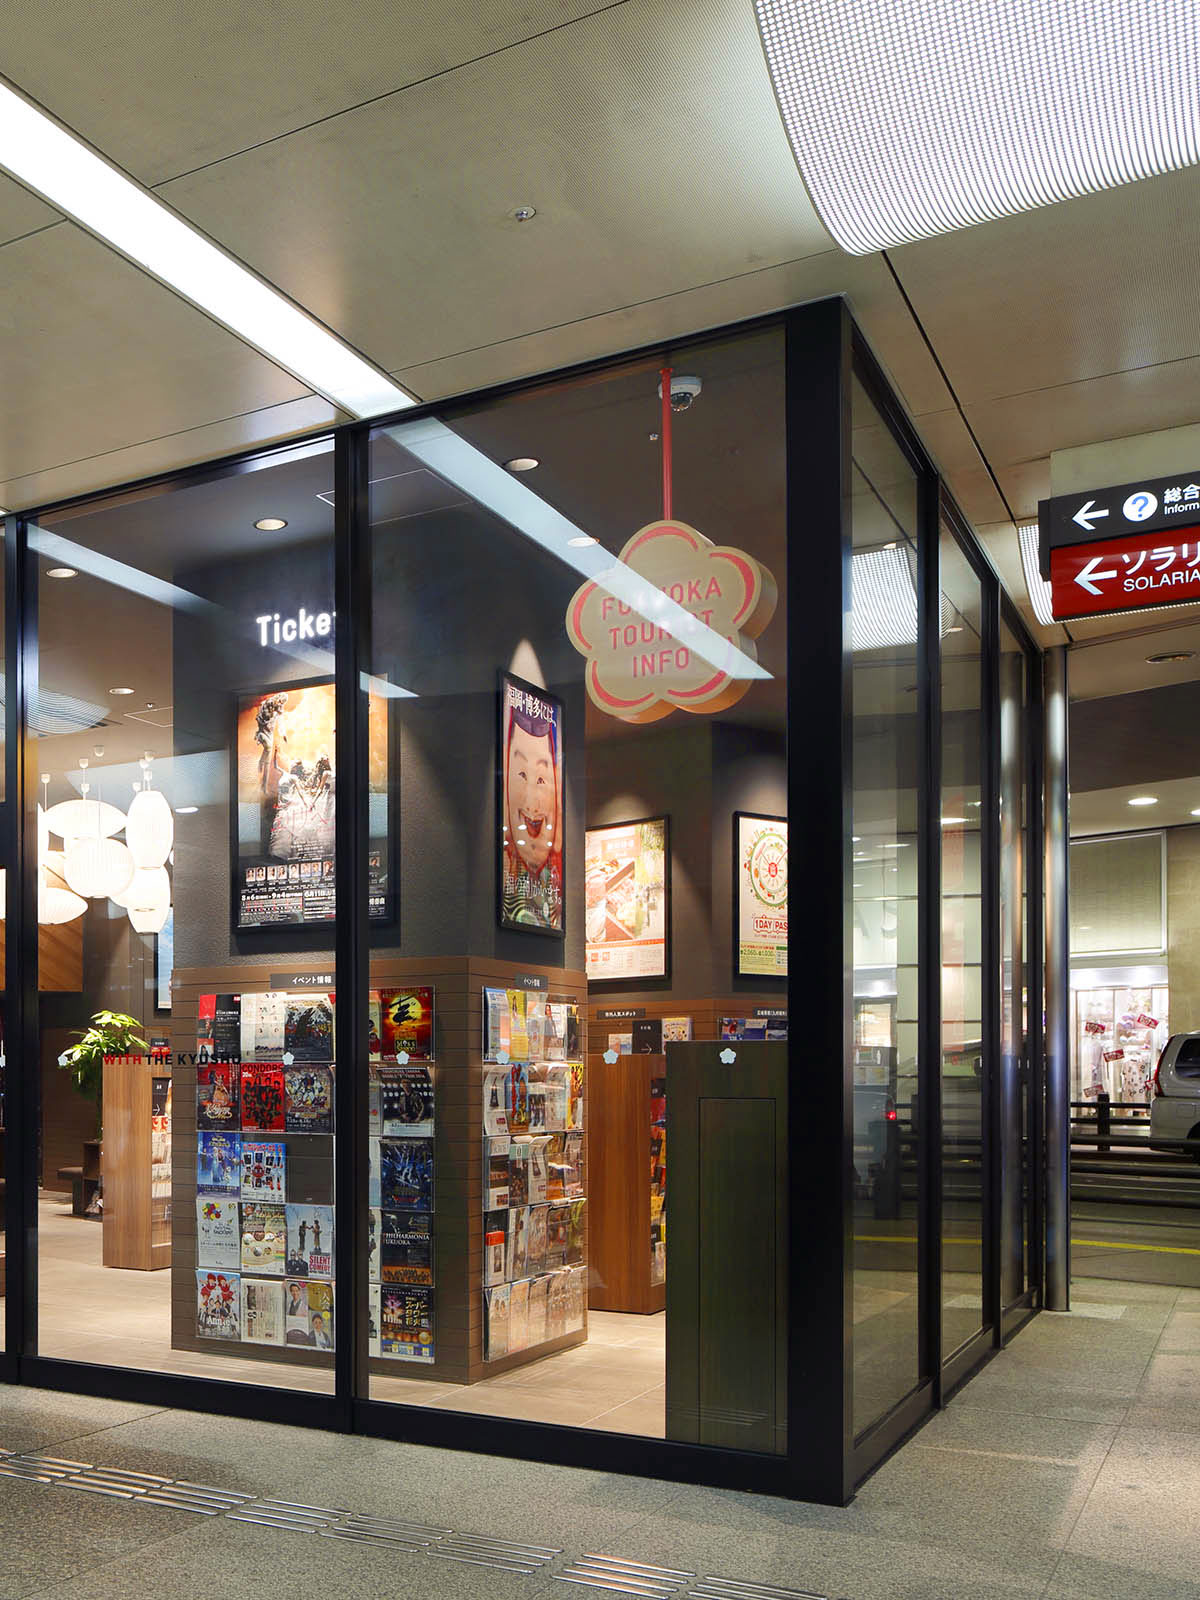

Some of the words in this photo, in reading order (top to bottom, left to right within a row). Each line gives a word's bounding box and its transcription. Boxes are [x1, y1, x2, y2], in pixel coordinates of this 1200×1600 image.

[1164, 484, 1200, 504] 総合
[1123, 569, 1200, 592] SOLARIA
[256, 608, 337, 647] Ticke
[633, 646, 689, 678] INFO
[292, 975, 332, 985] イベント情報
[103, 1053, 142, 1065] WITH
[145, 1053, 173, 1065] THE
[178, 1053, 242, 1065] KYUSHU
[242, 1064, 284, 1074] CONDORS
[309, 1255, 331, 1265] SILENT
